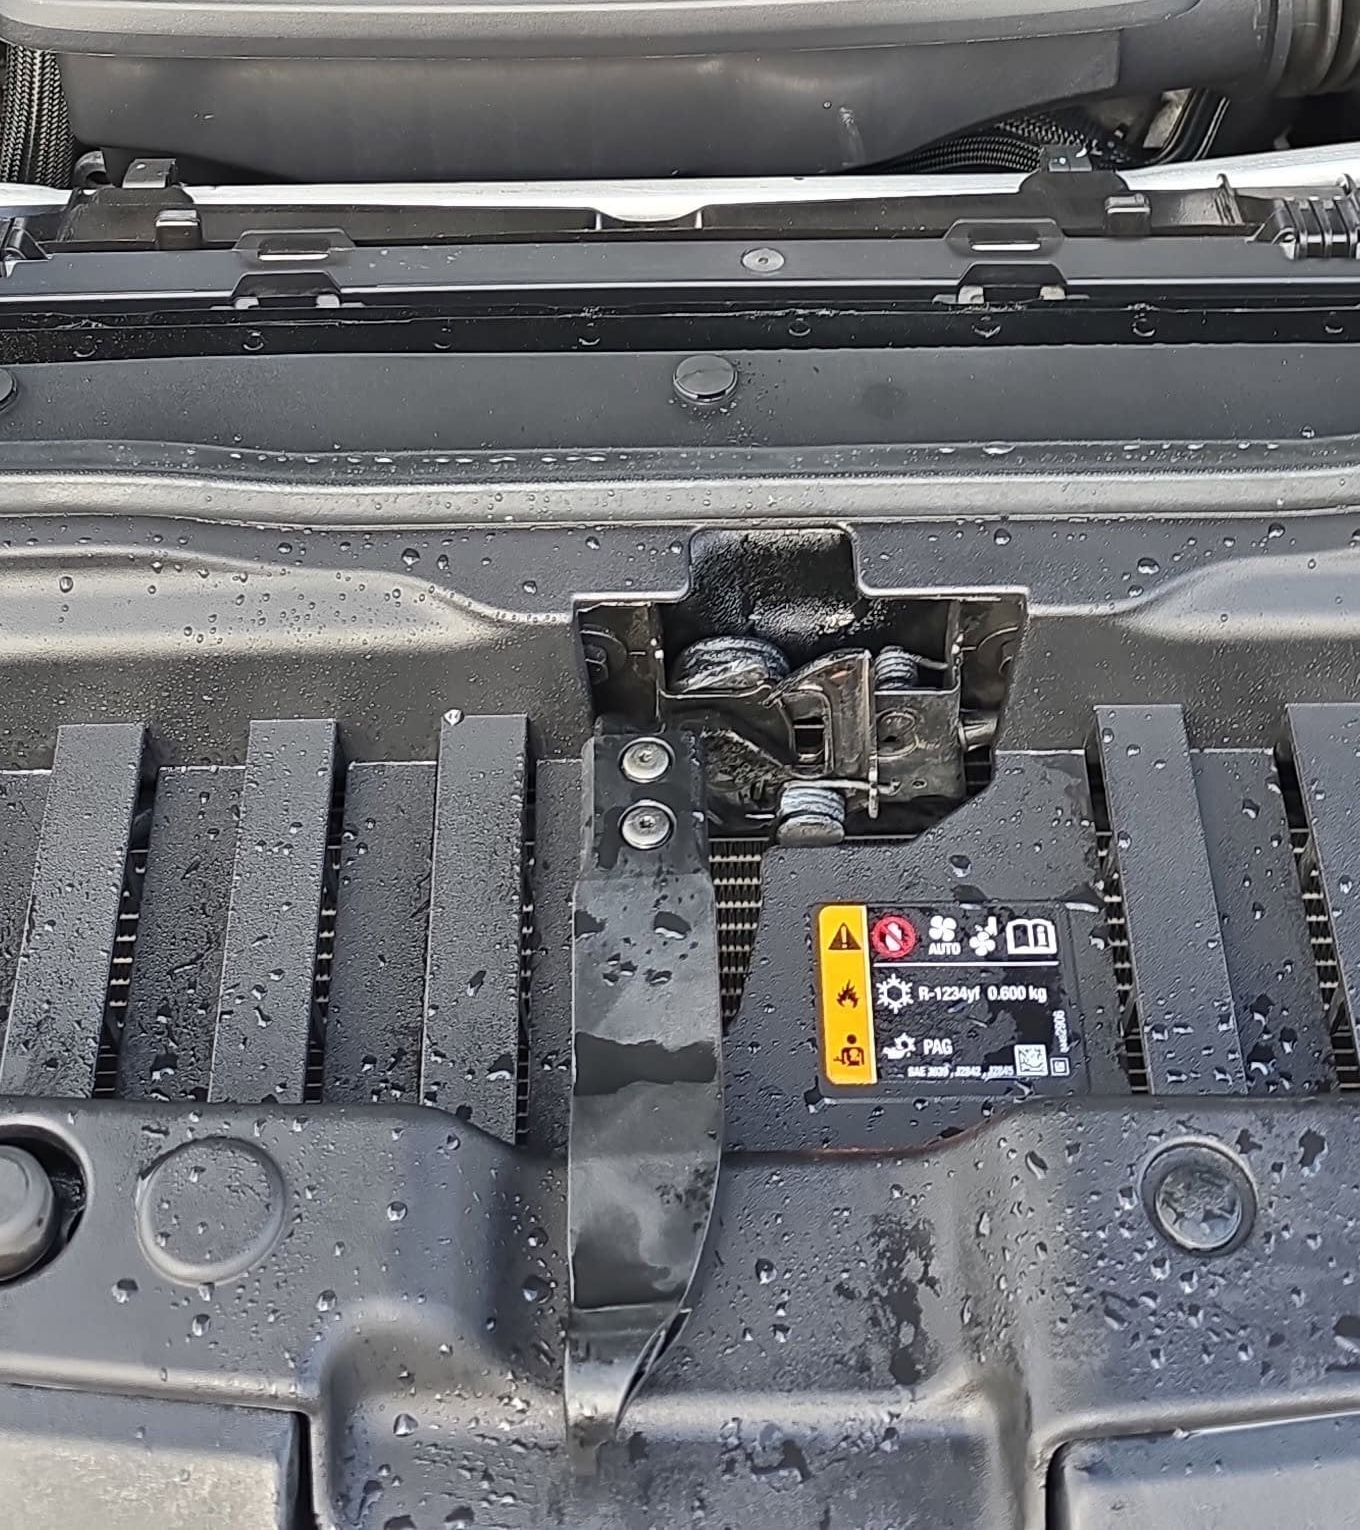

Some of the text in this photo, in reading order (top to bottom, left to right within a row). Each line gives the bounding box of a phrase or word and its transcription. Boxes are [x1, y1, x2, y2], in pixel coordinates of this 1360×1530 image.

[928, 941, 961, 956] AUTO
[918, 985, 1048, 1004] R-1234yf 0.600 kg
[923, 1038, 953, 1055] PAG
